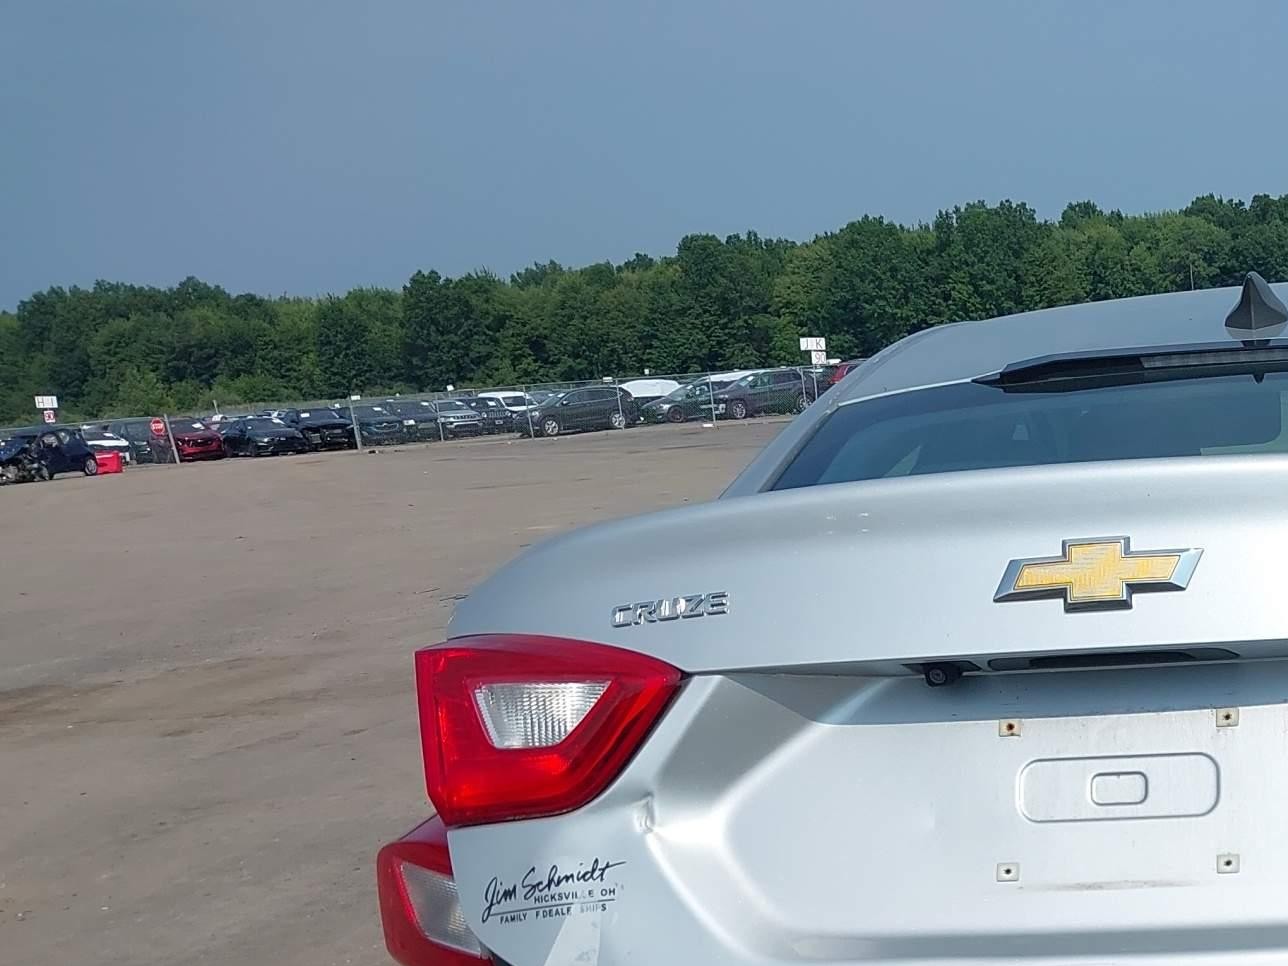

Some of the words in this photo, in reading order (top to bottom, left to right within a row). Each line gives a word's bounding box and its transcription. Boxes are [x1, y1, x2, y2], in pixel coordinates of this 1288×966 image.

[815, 338, 823, 350] K
[611, 591, 729, 628] CRUZE
[481, 876, 517, 924] Jim
[521, 857, 627, 901] Schmidt
[533, 889, 595, 905] HICKSVILE
[599, 887, 616, 898] OH
[500, 912, 528, 925] FAMILY
